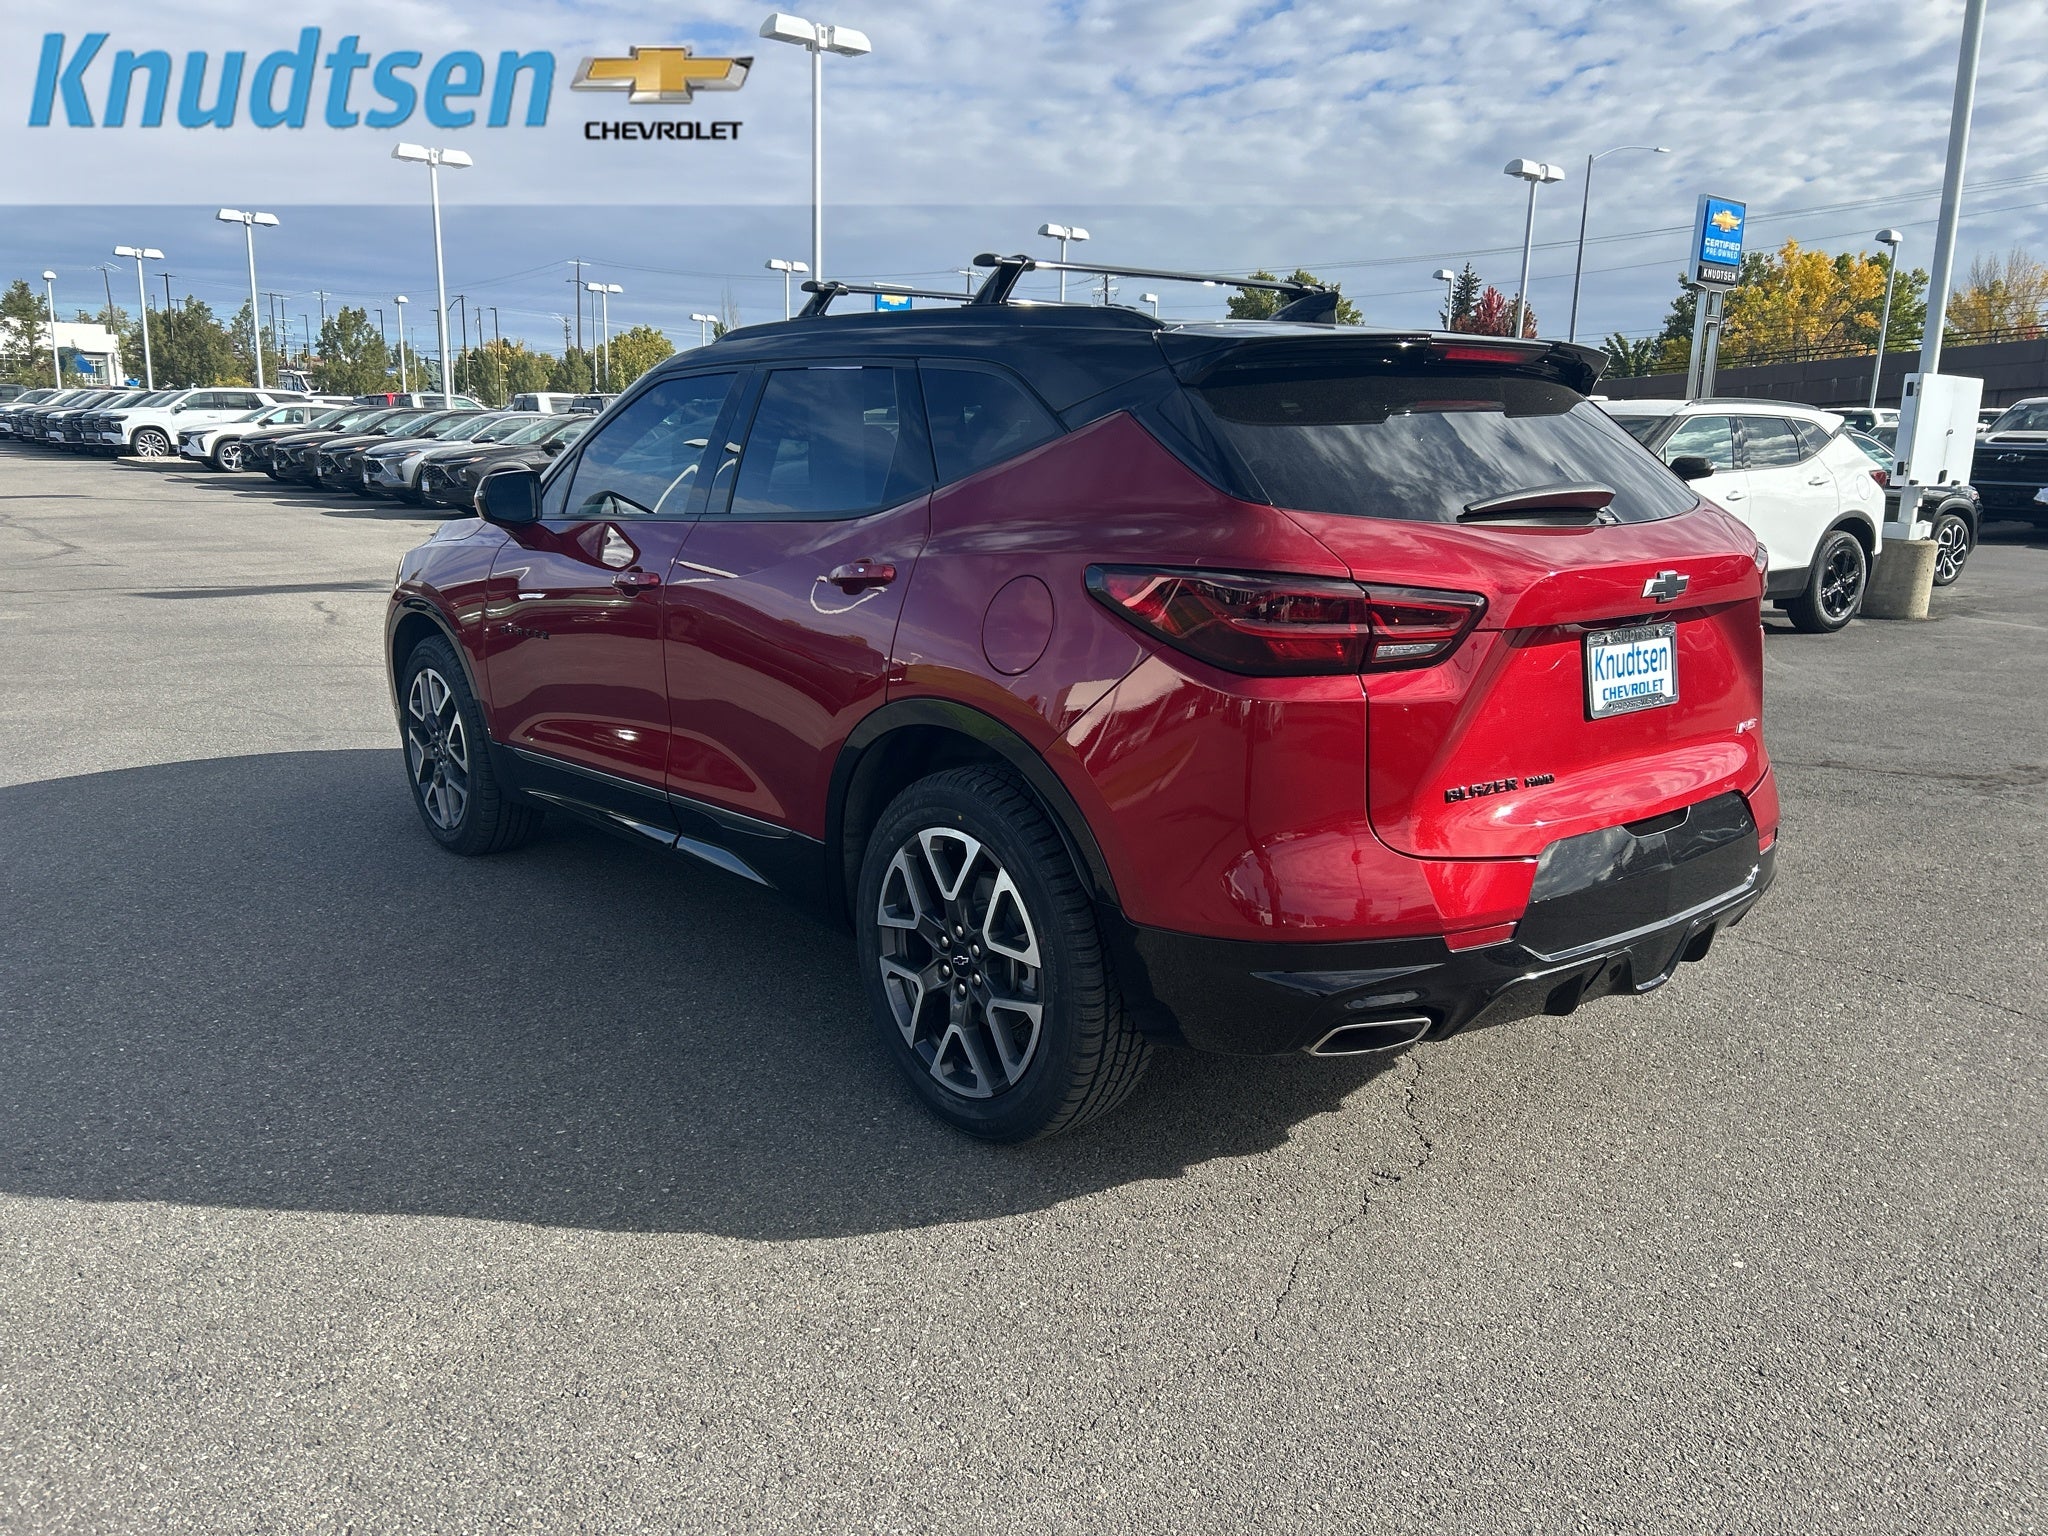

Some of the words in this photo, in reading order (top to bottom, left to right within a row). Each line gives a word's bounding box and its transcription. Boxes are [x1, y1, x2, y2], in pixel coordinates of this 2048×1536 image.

[1705, 237, 1741, 251] CERTIFIED
[1703, 268, 1736, 281] KNUDTSEN
[1595, 642, 1668, 682] Knudtsen
[1602, 678, 1664, 701] CHEVROLET
[1443, 777, 1519, 804] BLAZER
[1524, 773, 1556, 788] AWD
